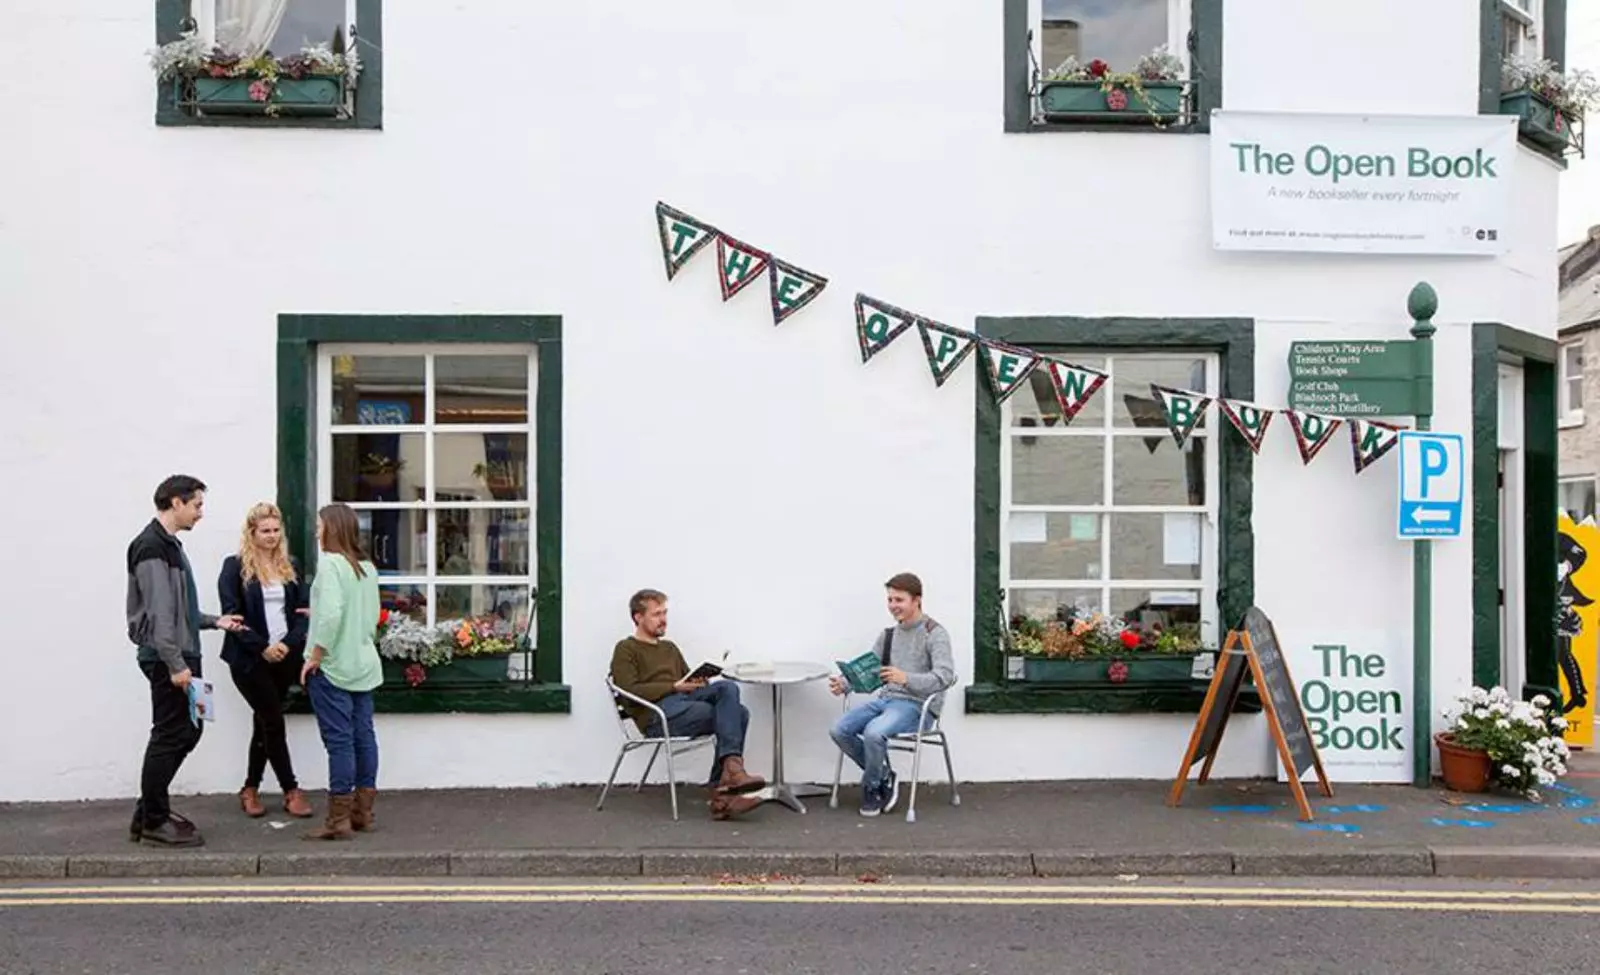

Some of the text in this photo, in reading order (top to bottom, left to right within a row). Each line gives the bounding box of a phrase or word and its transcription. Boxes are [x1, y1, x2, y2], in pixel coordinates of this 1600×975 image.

[1230, 143, 1497, 183] The Open Book
[1268, 186, 1460, 203] A new bookseller every fortnight
[671, 223, 826, 307] THE
[865, 313, 1087, 397] OPEN
[1294, 344, 1386, 355] Children's Play Area
[1295, 355, 1361, 364] Tennis Courts
[1295, 366, 1348, 376] Book Shops
[1294, 382, 1339, 391] Golf Club
[1339, 393, 1360, 402] Park
[1339, 404, 1381, 413] Distillery
[1420, 440, 1448, 498] P
[1312, 645, 1385, 677] The
[1301, 680, 1402, 721] Open
[1307, 717, 1404, 750] Book
